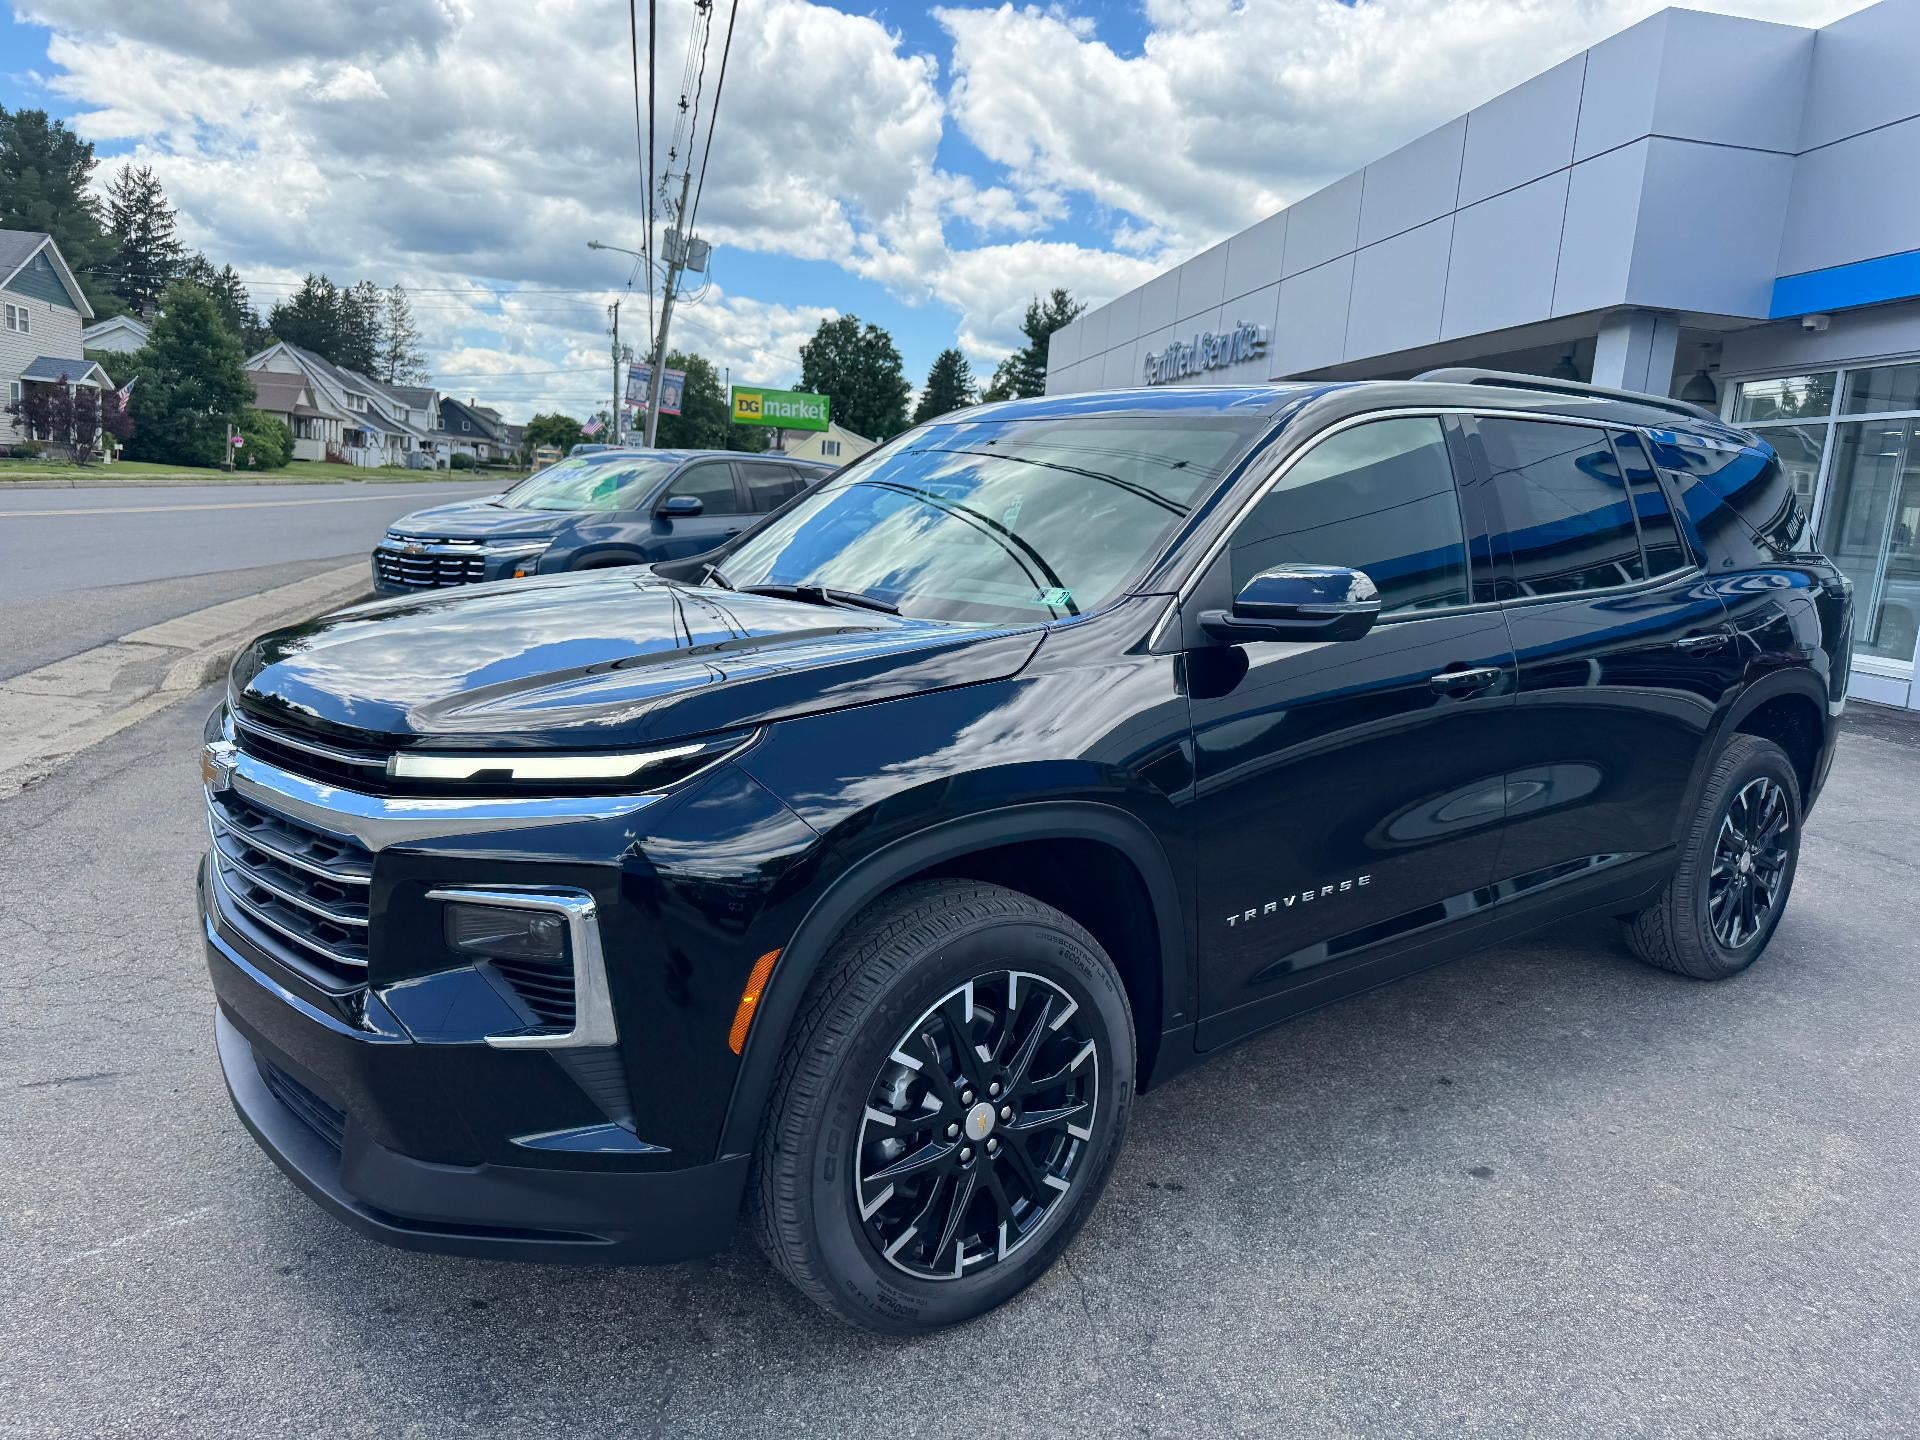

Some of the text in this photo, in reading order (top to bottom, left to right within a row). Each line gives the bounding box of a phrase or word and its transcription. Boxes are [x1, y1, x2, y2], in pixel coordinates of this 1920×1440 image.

[1143, 319, 1265, 386] Certified Service
[737, 399, 827, 421] DG market
[1226, 874, 1371, 927] TRAVERSE
